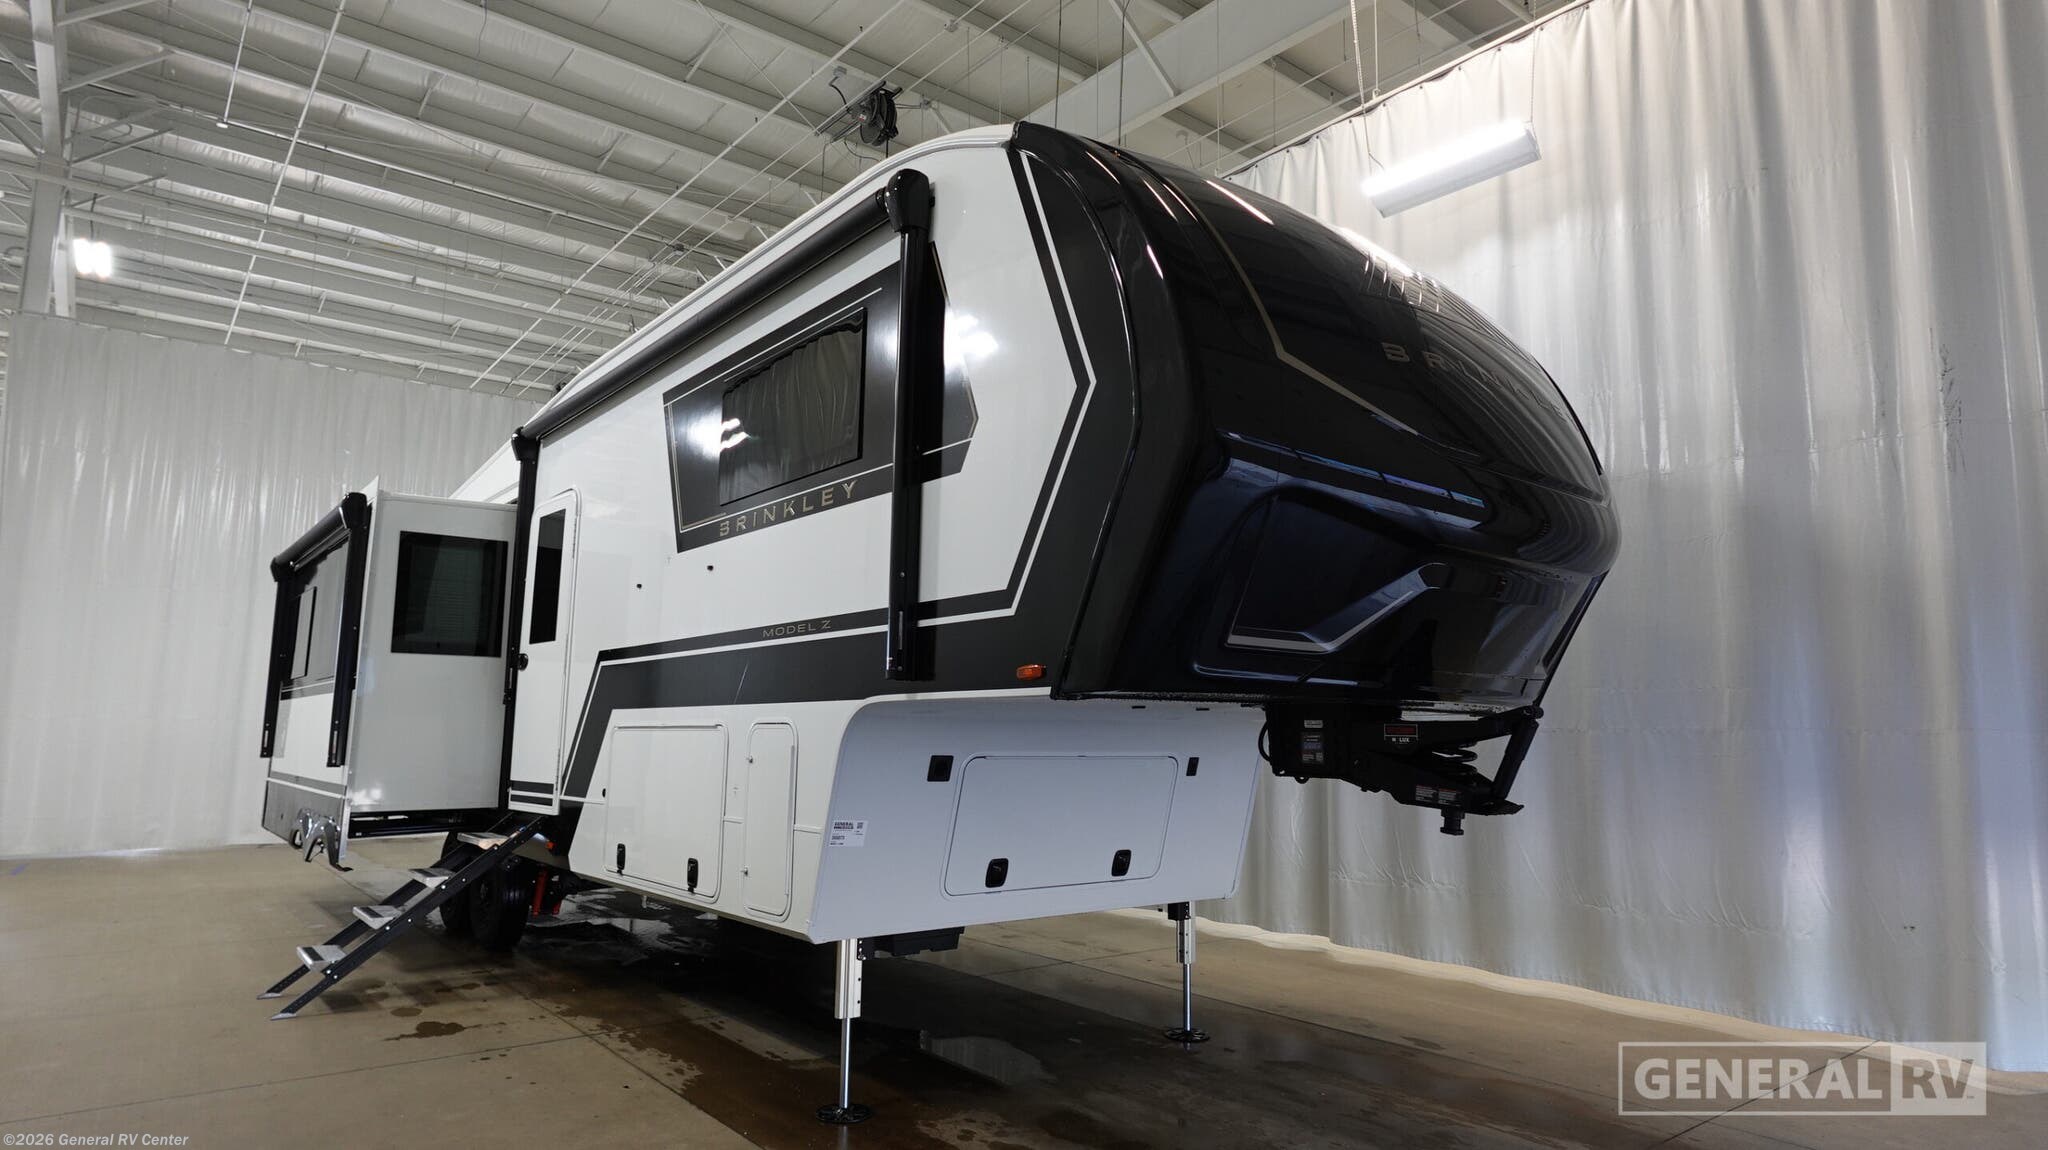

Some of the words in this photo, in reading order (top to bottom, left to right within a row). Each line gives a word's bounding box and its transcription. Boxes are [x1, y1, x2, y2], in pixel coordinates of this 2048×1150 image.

[719, 480, 858, 537] BRINKLEY
[762, 622, 816, 638] MODEL
[821, 619, 831, 630] Z
